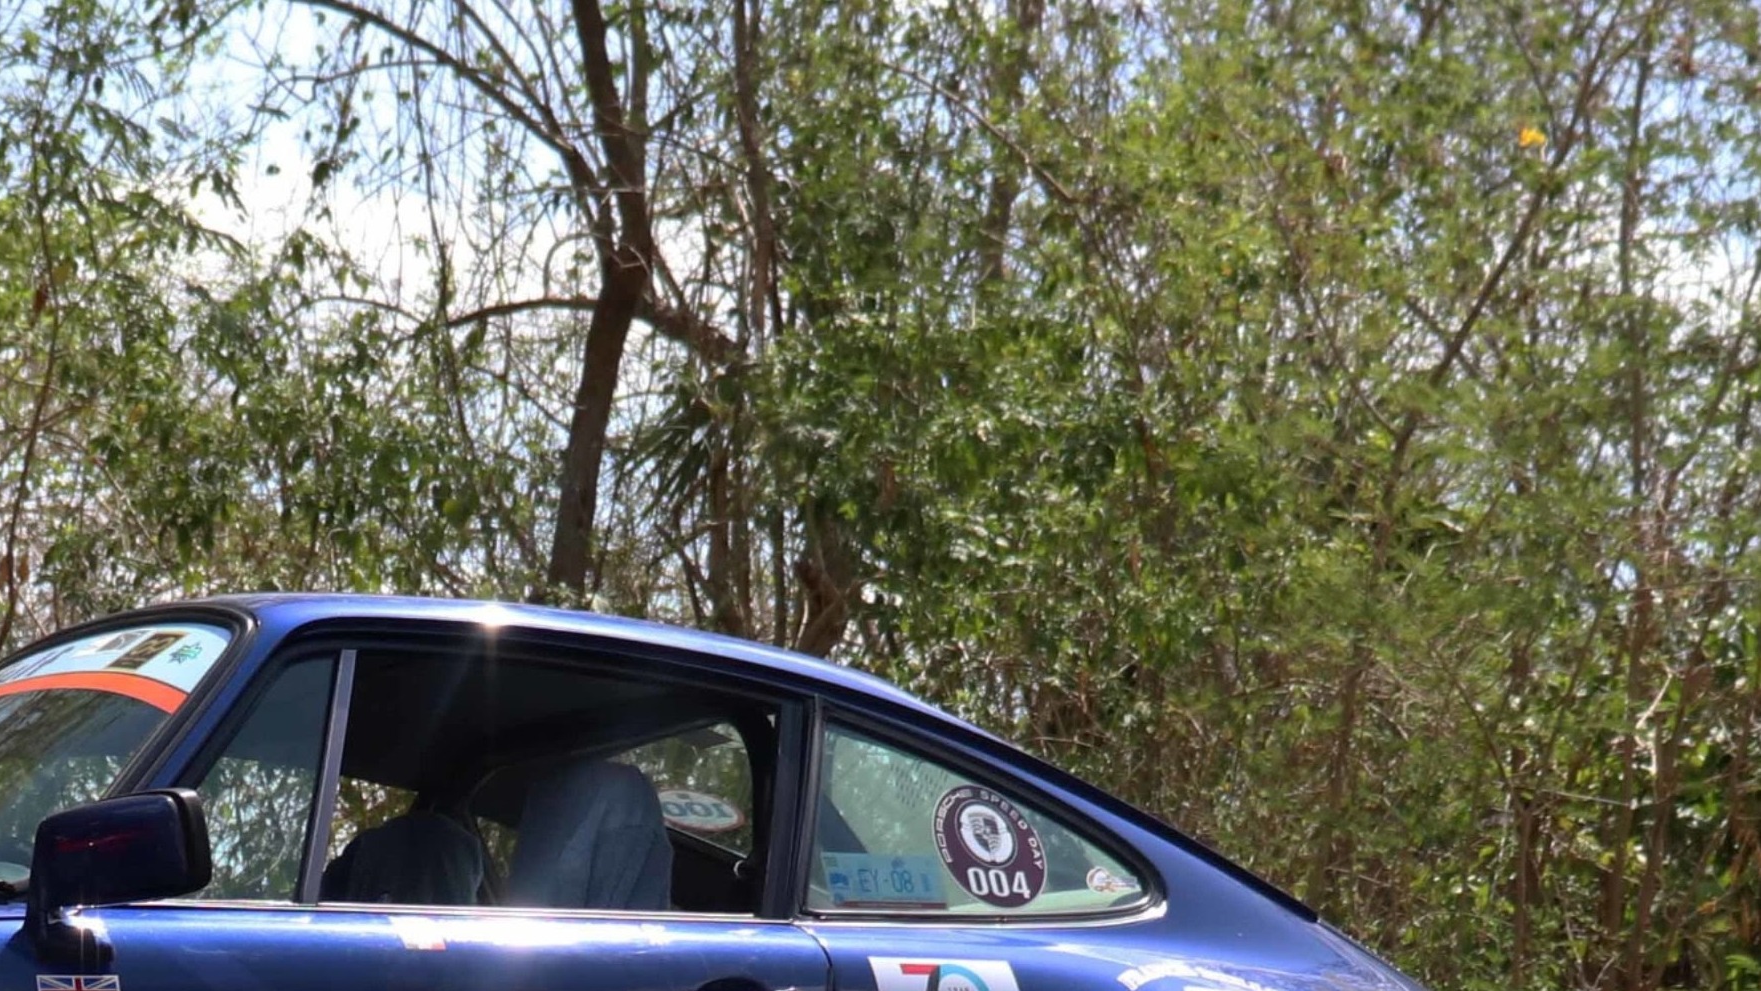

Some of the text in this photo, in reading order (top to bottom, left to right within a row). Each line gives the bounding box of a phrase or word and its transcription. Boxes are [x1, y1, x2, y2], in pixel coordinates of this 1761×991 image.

[937, 789, 1044, 870] PORSCHE SPEED DAY
[967, 866, 1031, 899] 004
